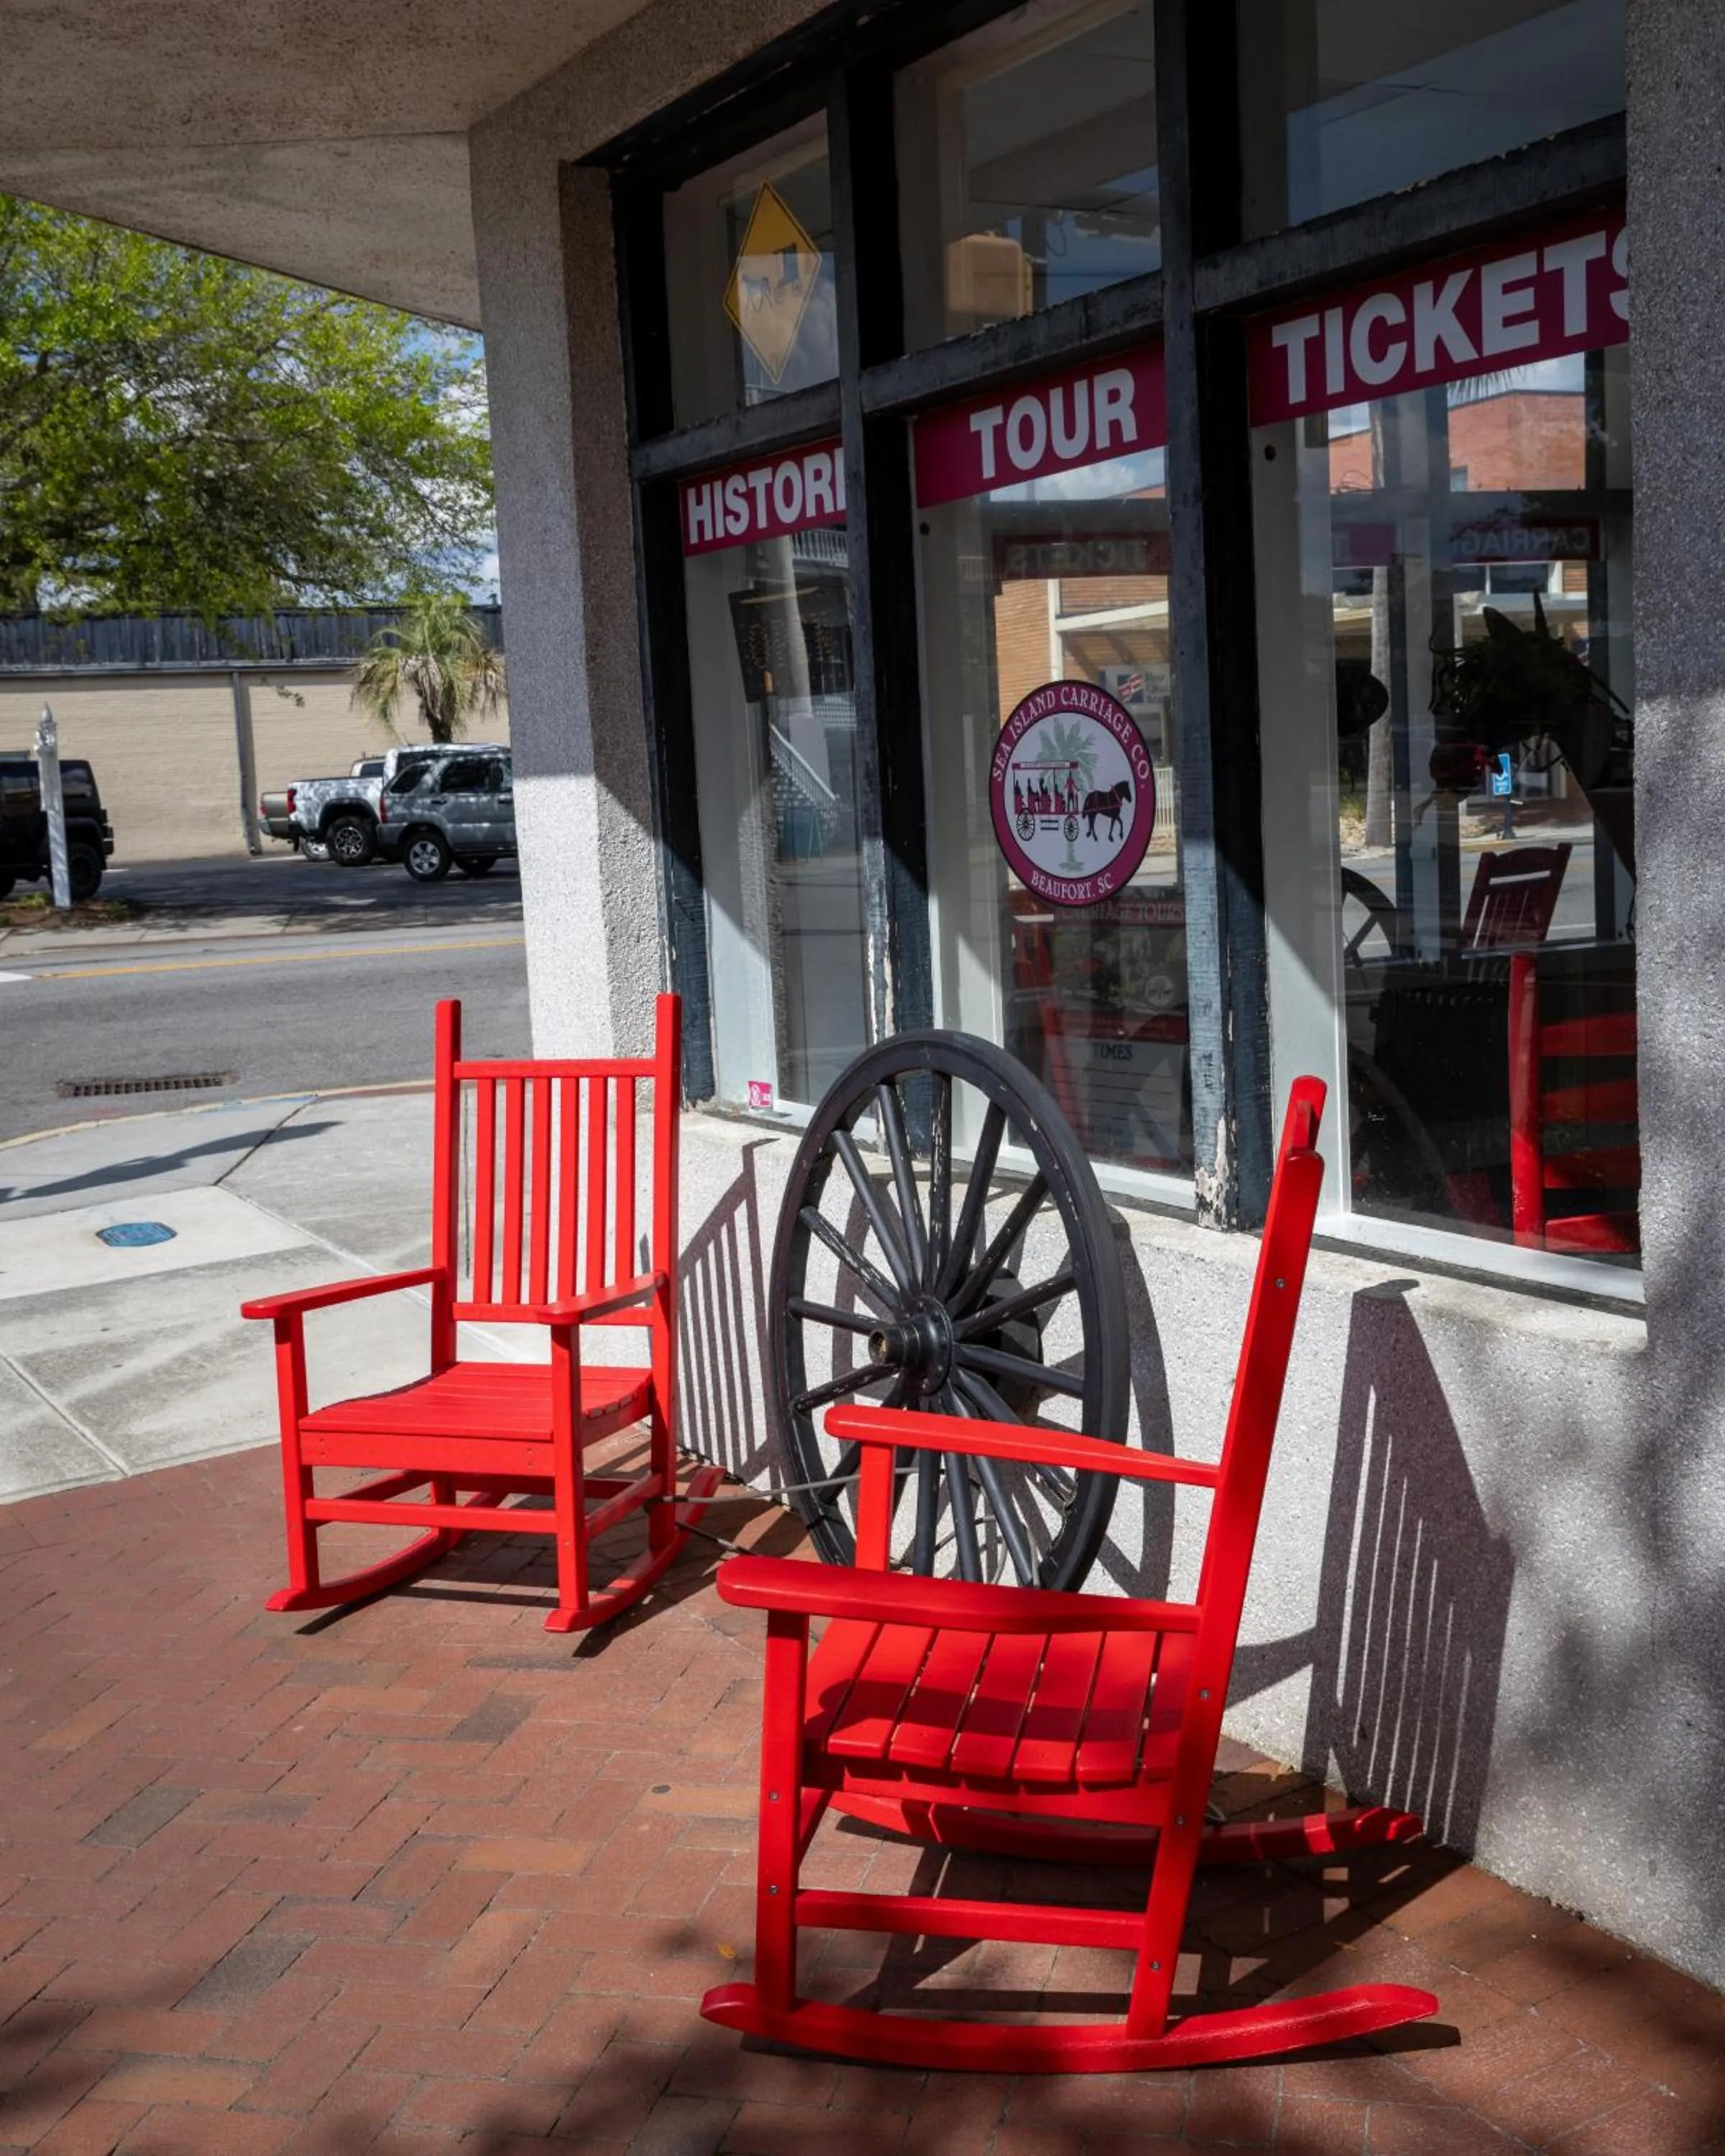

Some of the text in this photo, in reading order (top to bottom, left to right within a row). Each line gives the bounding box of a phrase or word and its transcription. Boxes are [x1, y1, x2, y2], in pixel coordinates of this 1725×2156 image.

[970, 368, 1138, 480] TOUR
[687, 446, 847, 544] HISTORI
[993, 743, 1012, 781] SEA
[1009, 691, 1056, 740] ISLAND
[1060, 686, 1132, 743] CARRIAGE
[1097, 873, 1114, 894] SC
[1092, 1043, 1133, 1061] TIMES
